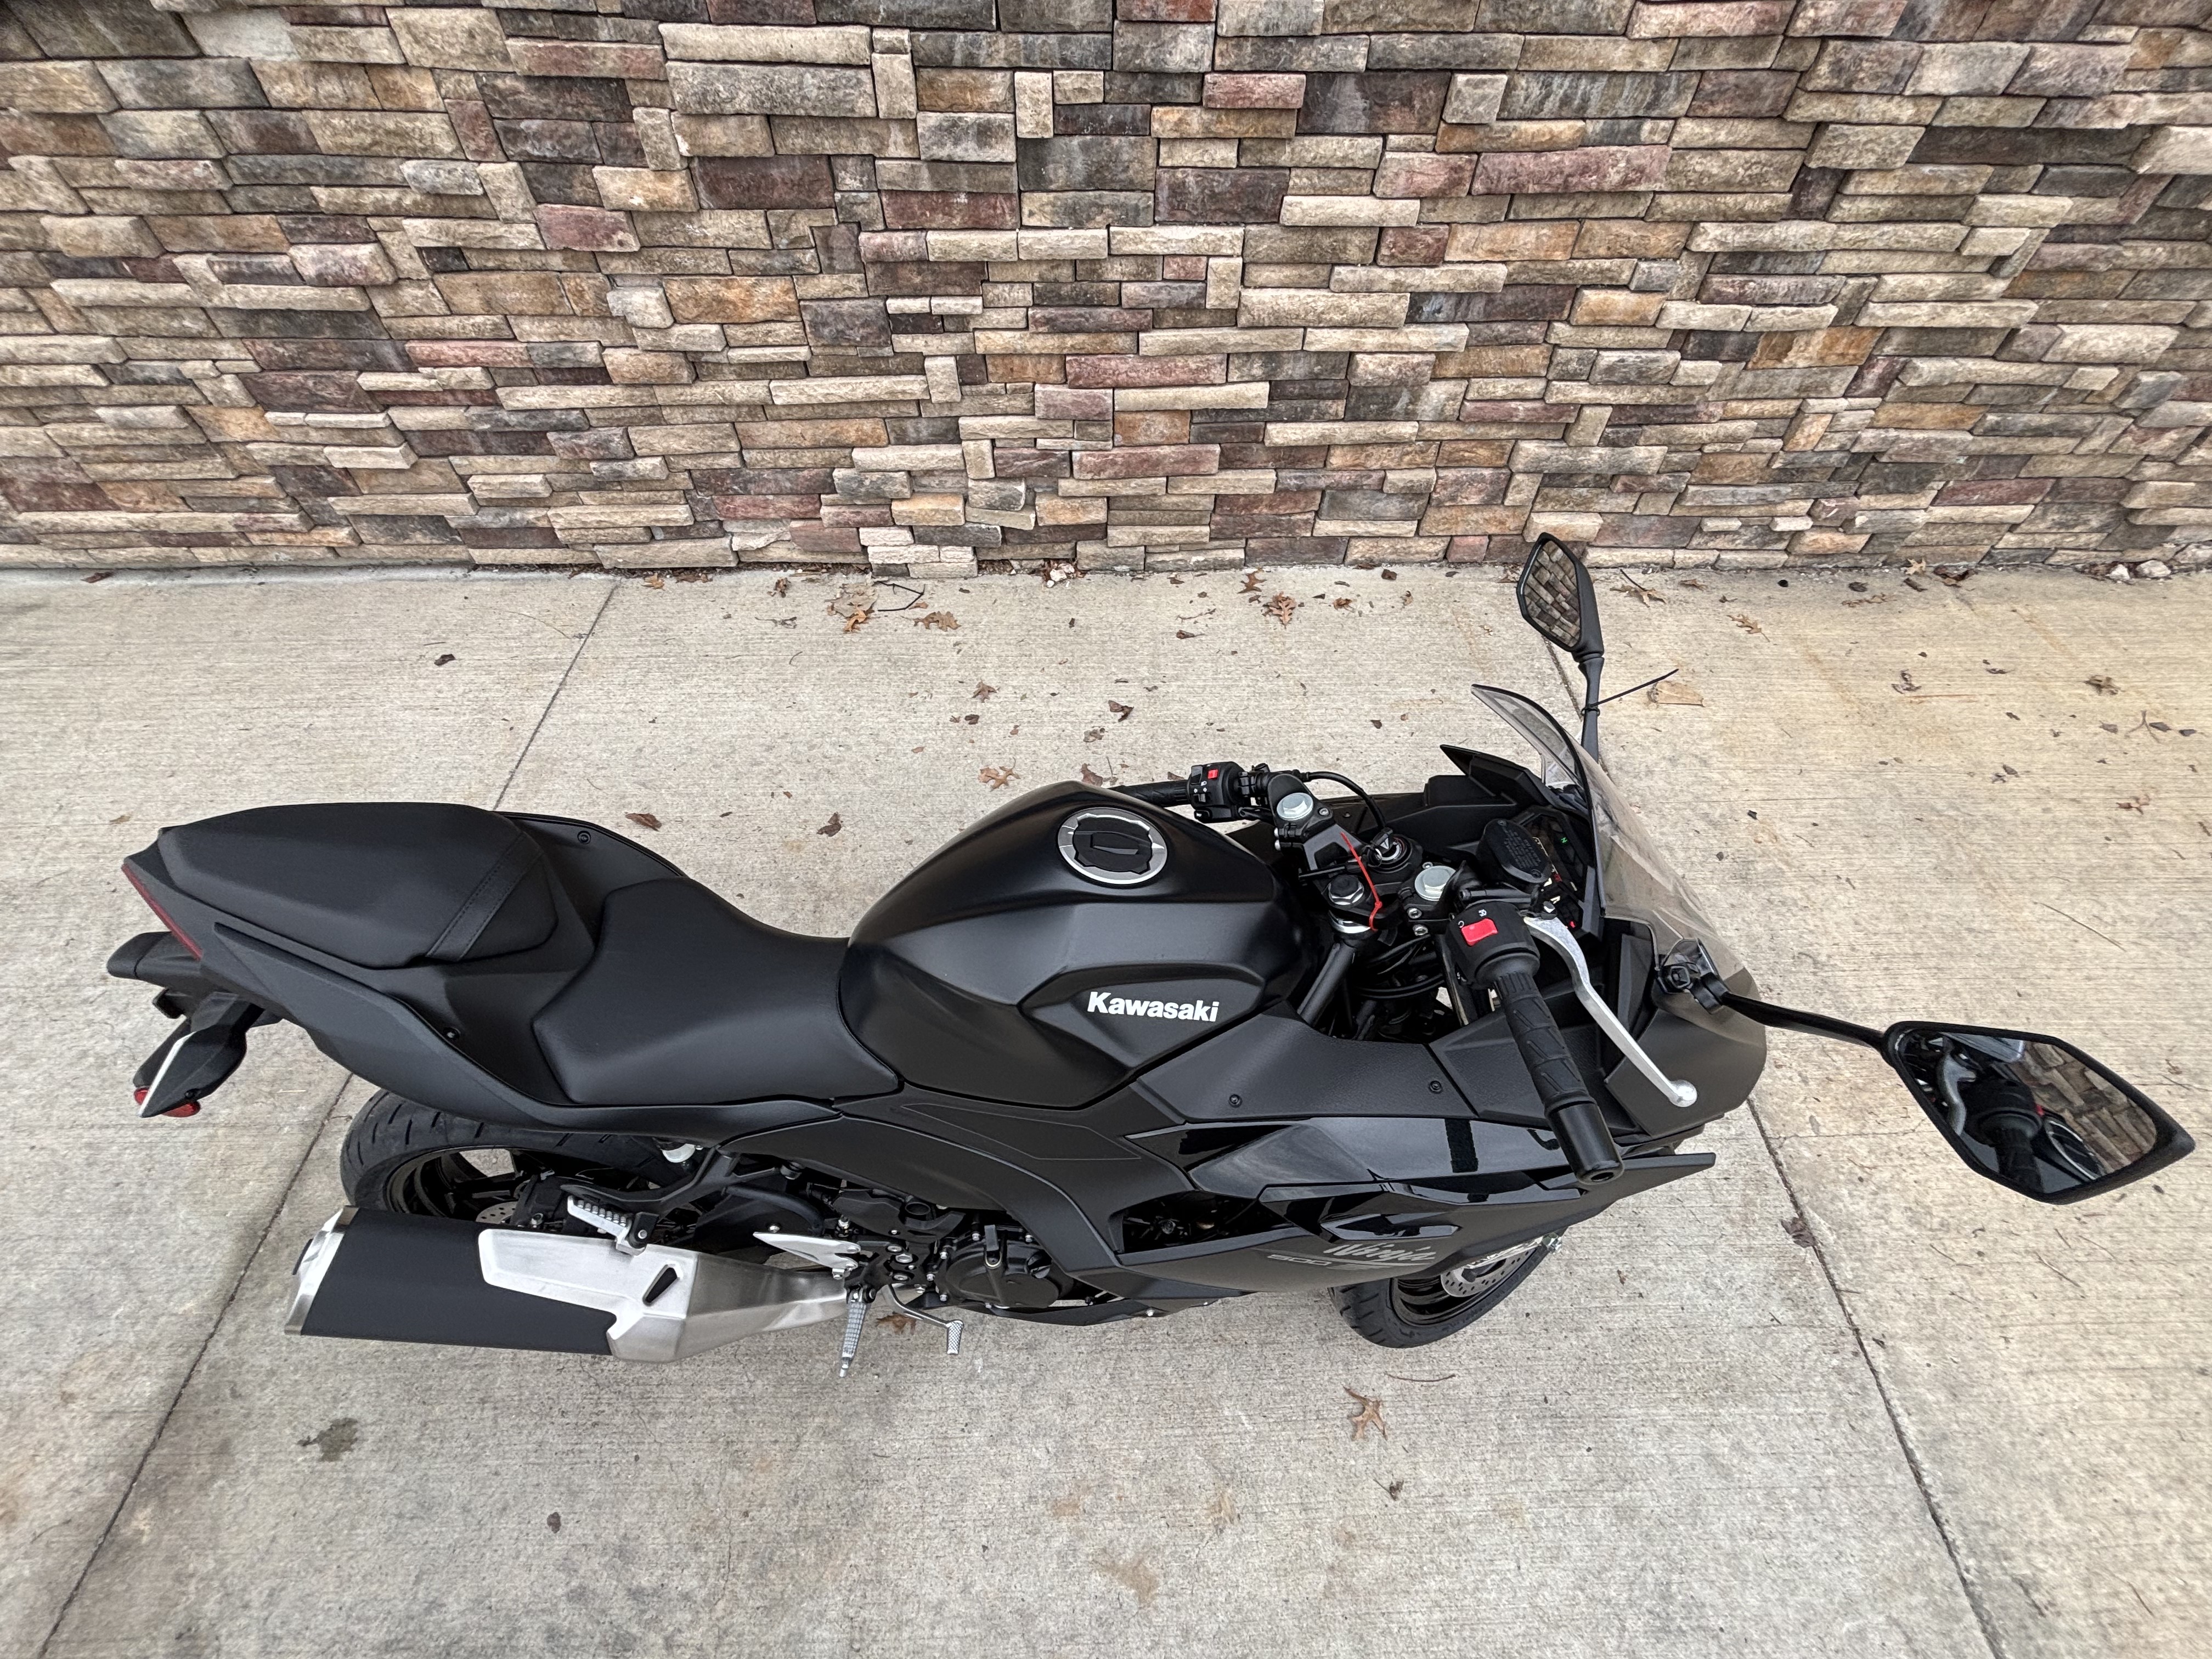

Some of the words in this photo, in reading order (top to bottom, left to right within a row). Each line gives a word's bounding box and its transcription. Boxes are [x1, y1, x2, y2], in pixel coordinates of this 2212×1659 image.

[1087, 991, 1220, 1022] Kawasaki
[1267, 1254, 1332, 1266] 500
[1323, 1243, 1437, 1262] Ninja
